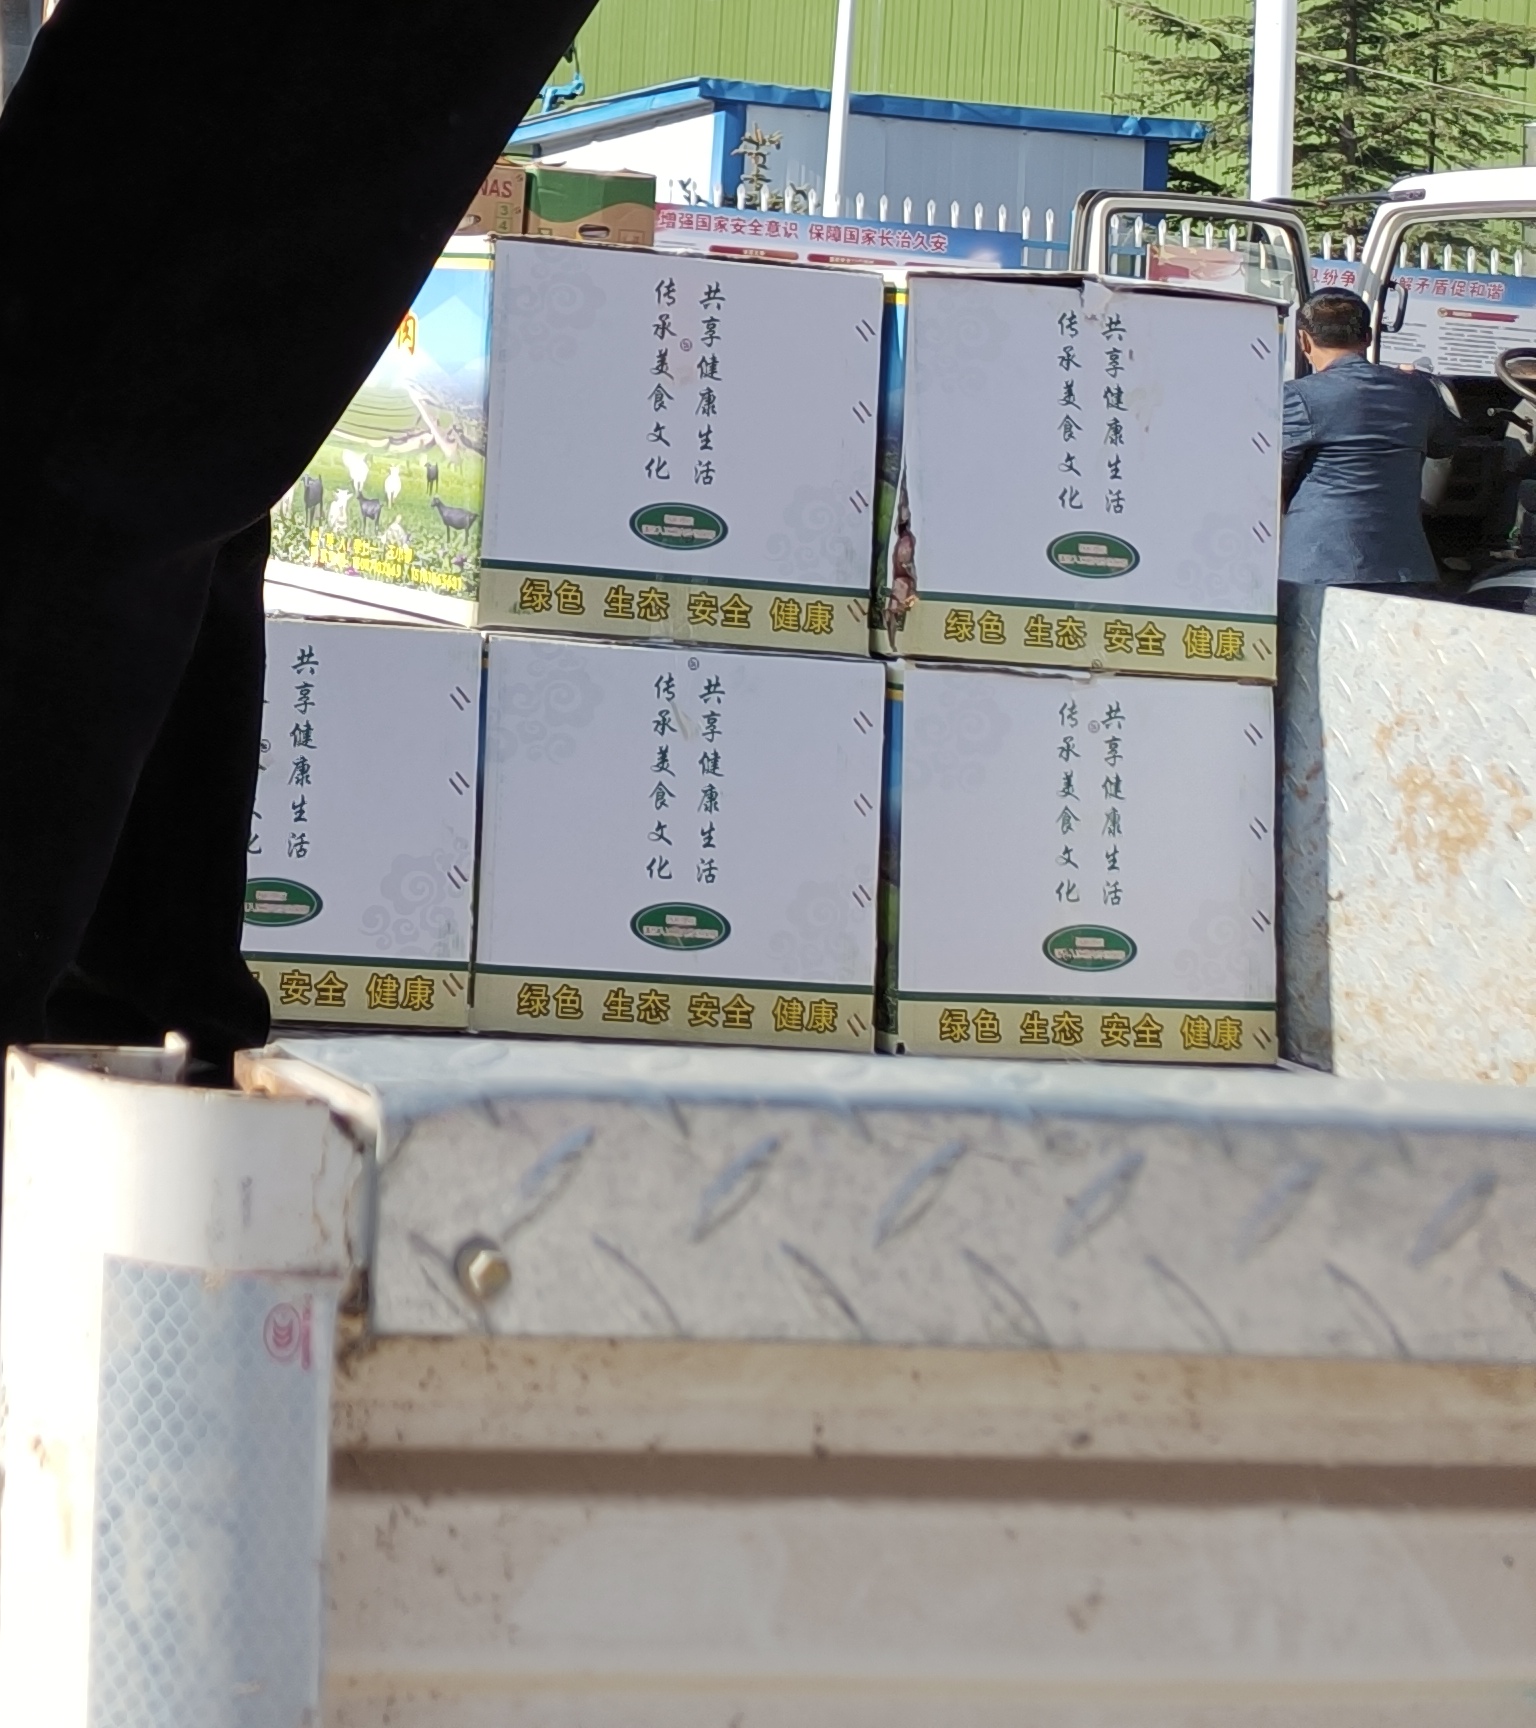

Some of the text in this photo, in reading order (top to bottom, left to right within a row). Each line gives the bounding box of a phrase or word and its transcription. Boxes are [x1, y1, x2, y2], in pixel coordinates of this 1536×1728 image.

[659, 211, 948, 253] 增强国家安全意识 保障国家长治久安
[1391, 275, 1504, 301] 解矛盾促和谐
[645, 278, 676, 479] 传承美食文化
[694, 282, 726, 485] 共享健康生活
[1058, 311, 1083, 509] 传承美食文化
[1102, 314, 1127, 513] 共享健康生活
[520, 579, 833, 634] 绿色 生态 安全 健康
[945, 610, 1243, 660] 绿色 生态 安全 健康
[288, 645, 319, 858] 共享健康生活
[647, 673, 677, 879] 传承美食文化
[697, 675, 725, 883] 共享健康生活
[1056, 701, 1080, 902] 传承美食文化
[1102, 702, 1125, 905] 共享健康生活
[280, 970, 434, 1011] 安全 健康
[517, 983, 838, 1033] 绿色 生态 安全 健康
[939, 1009, 1242, 1051] 绿色 生态 安全 健康
